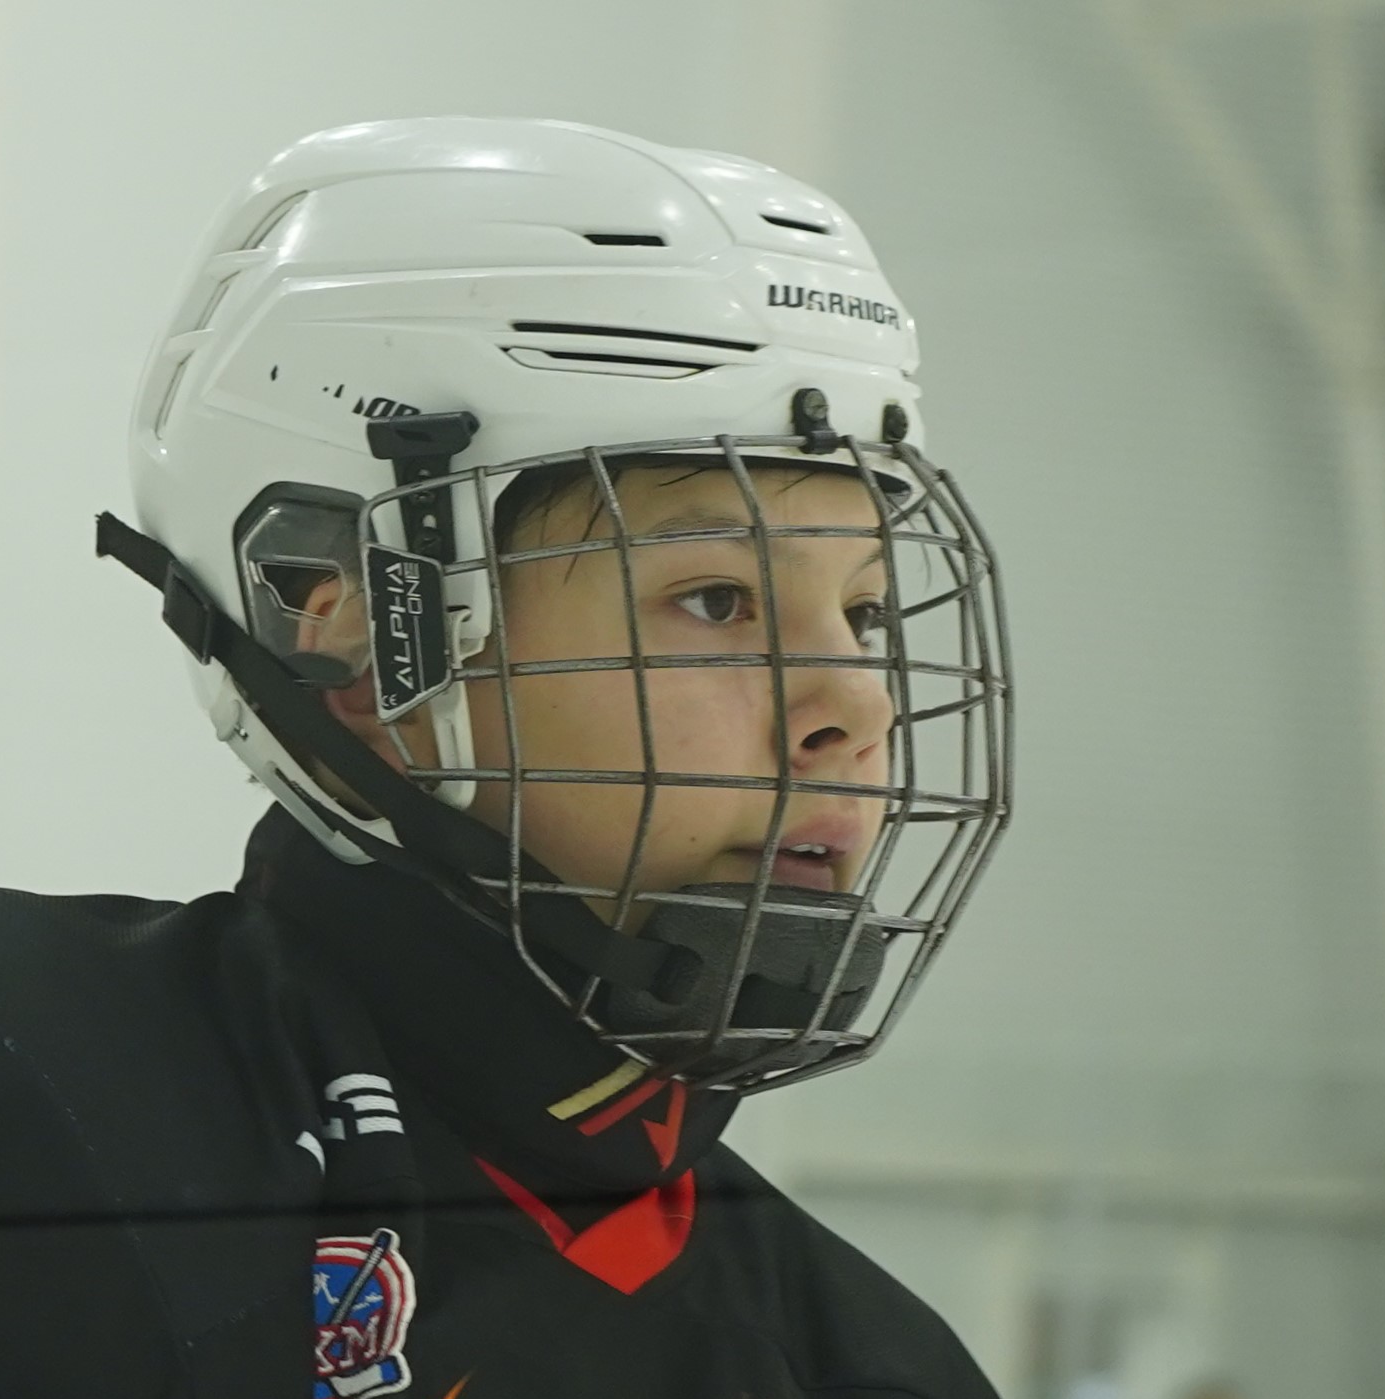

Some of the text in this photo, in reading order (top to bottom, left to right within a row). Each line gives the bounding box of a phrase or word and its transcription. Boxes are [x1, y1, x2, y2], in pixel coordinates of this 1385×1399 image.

[767, 284, 901, 330] WARRIOR
[402, 561, 423, 616] ONE
[385, 562, 414, 690] ALPHA
